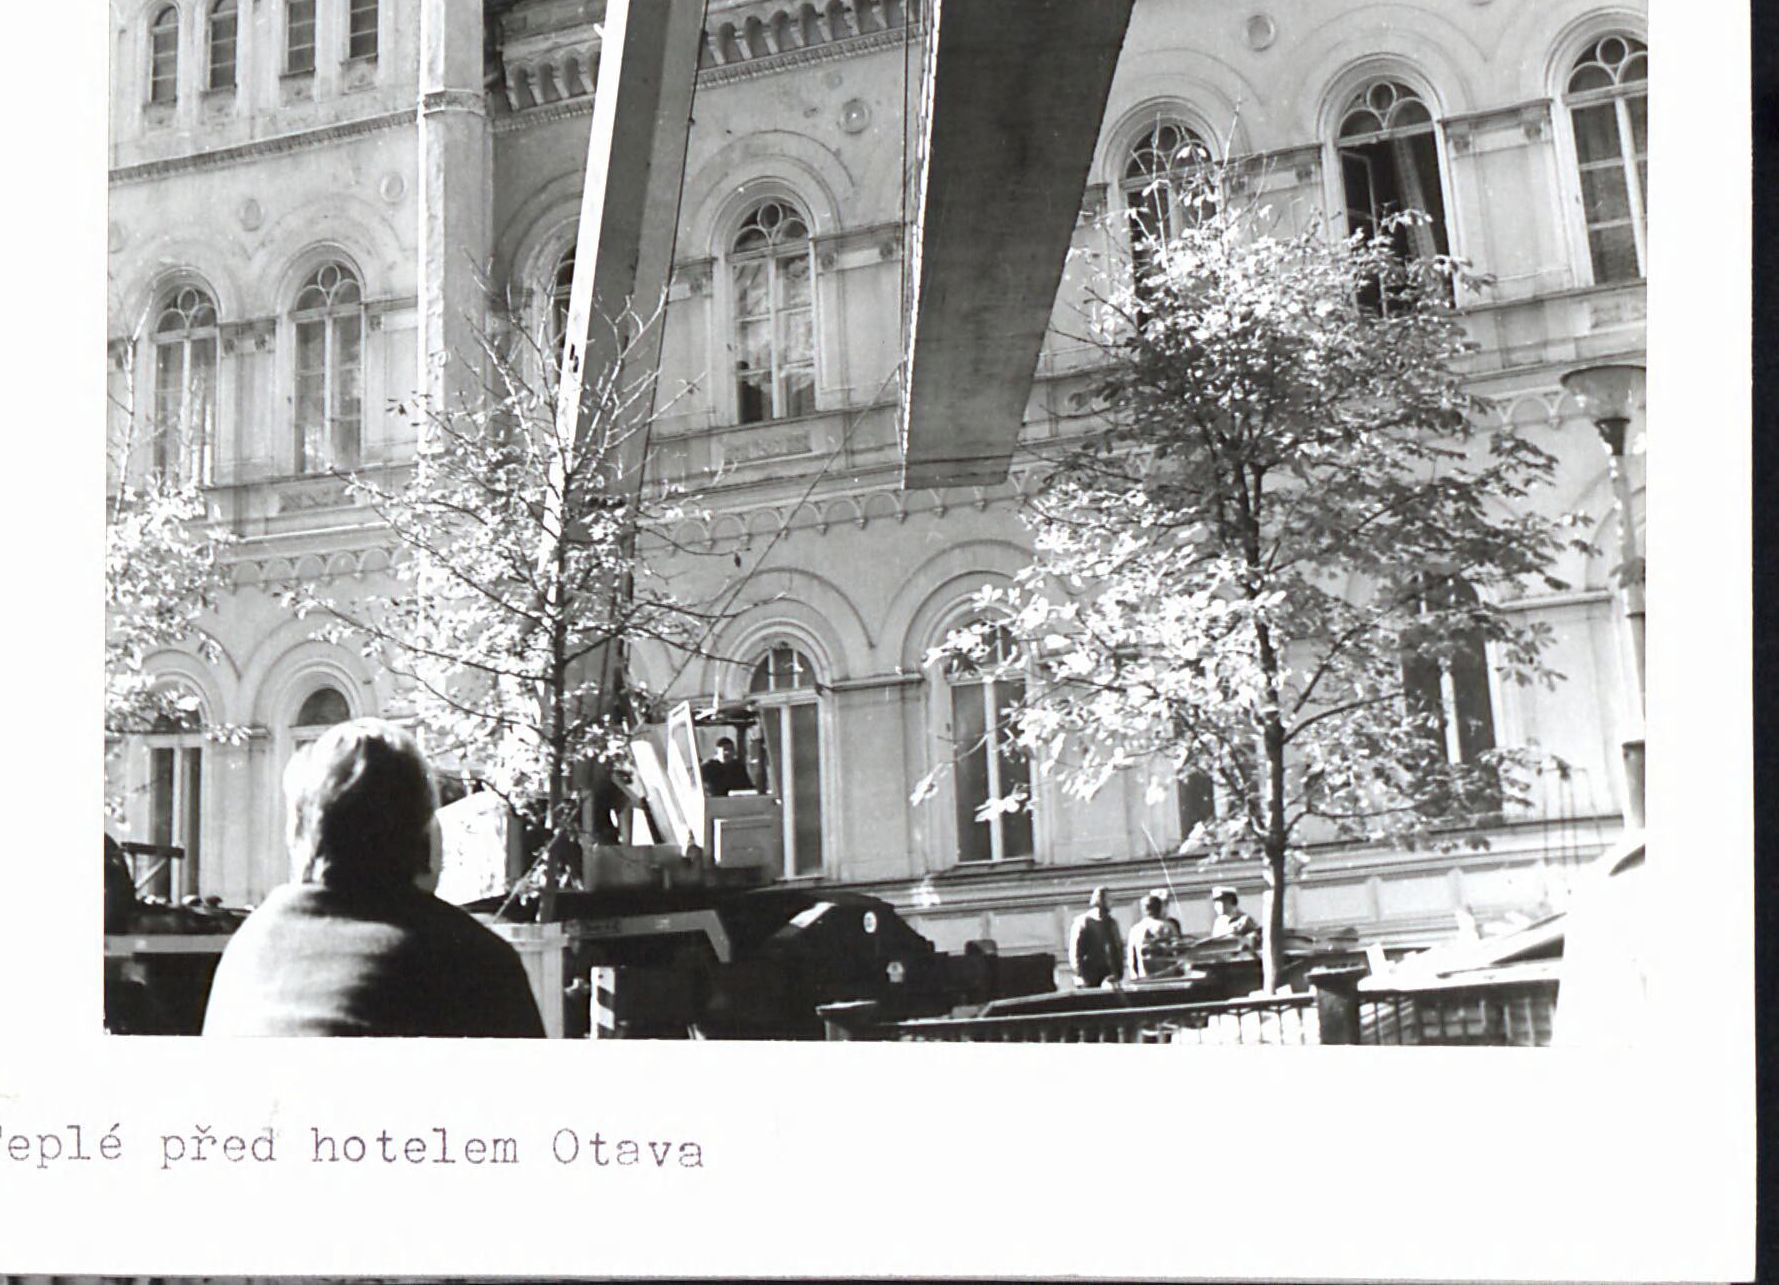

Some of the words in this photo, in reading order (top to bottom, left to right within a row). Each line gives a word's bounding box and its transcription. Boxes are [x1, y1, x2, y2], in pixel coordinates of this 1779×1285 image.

[160, 1124, 277, 1170] před
[310, 1126, 519, 1165] hotelem
[552, 1128, 705, 1168] Otava
